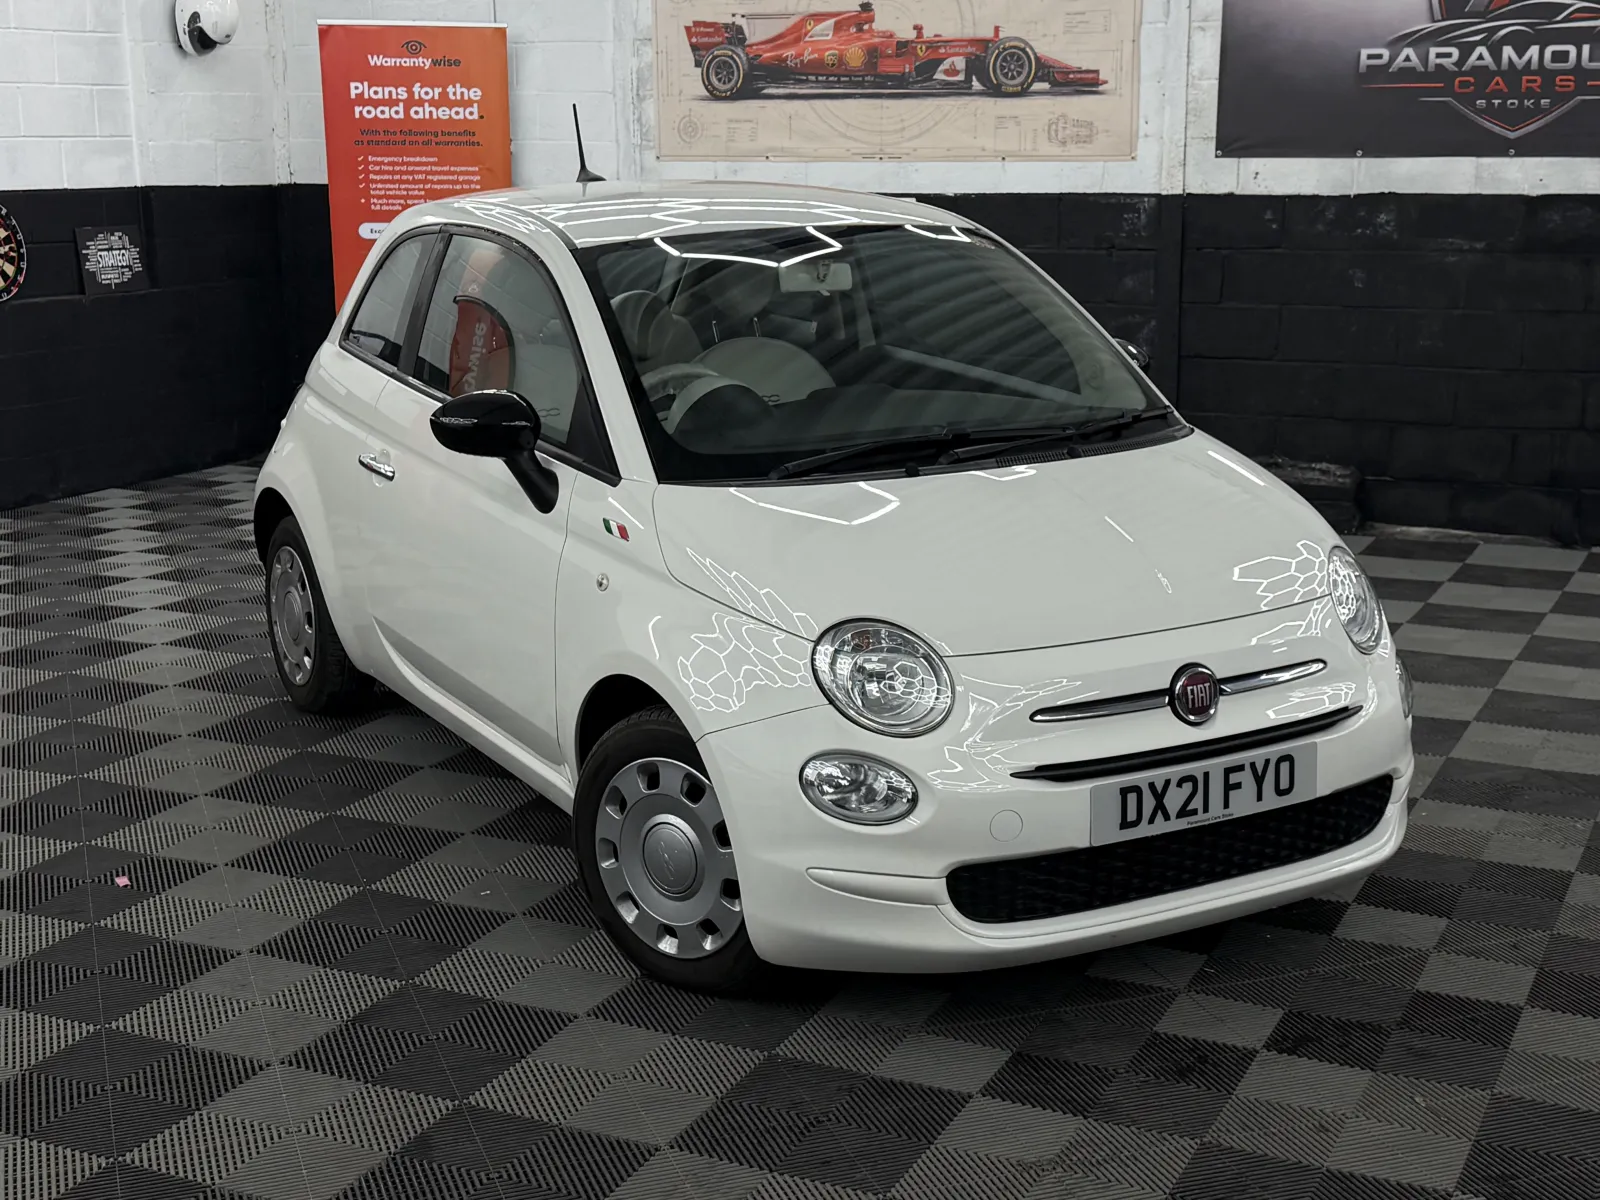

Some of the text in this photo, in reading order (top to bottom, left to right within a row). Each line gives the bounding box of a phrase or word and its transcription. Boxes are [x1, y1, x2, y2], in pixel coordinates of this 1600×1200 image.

[367, 54, 462, 70] Warrantywise
[349, 81, 482, 100] Plans for the
[1453, 75, 1577, 93] CARS
[354, 102, 485, 120] road ahead.
[1475, 98, 1551, 110] STOKE
[399, 129, 439, 138] following
[441, 129, 477, 137] benefits
[367, 138, 407, 146] standard
[421, 138, 433, 146] all
[434, 139, 483, 147] warranties.
[368, 155, 403, 163] Emergency
[97, 249, 129, 268] STRATEGY
[1186, 682, 1211, 709] FIAT
[1119, 753, 1295, 831] DX21 FYO
[1187, 817, 1211, 826] Paramount
